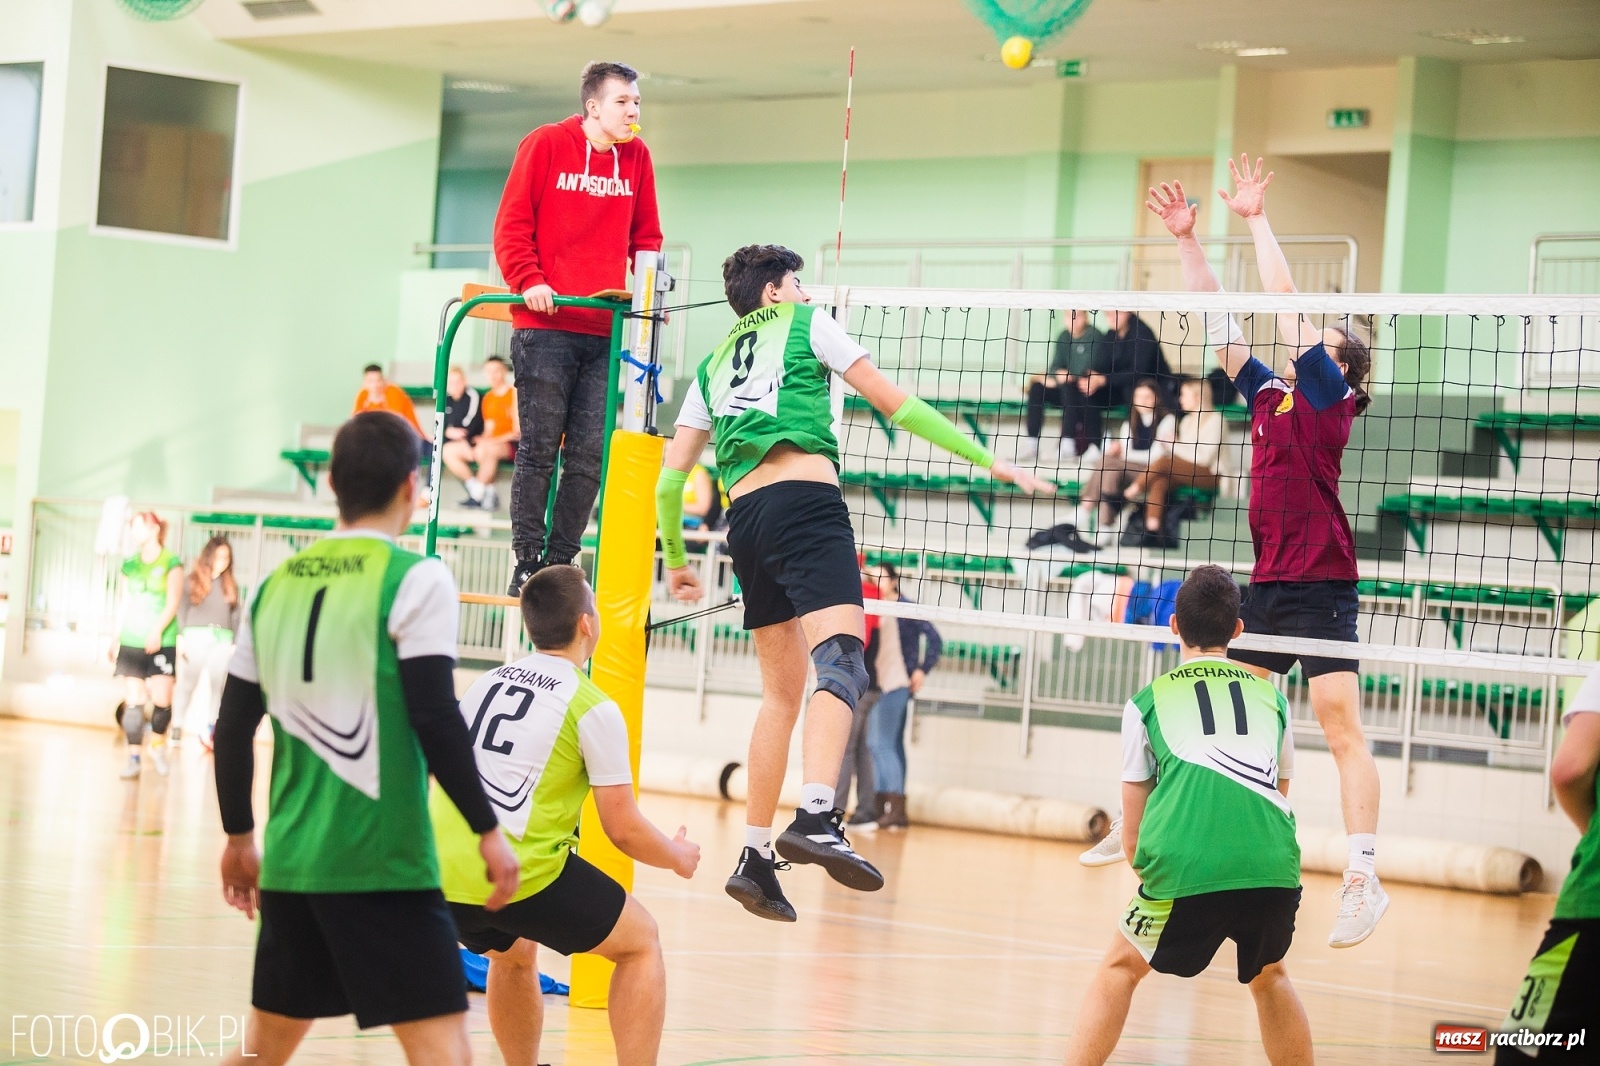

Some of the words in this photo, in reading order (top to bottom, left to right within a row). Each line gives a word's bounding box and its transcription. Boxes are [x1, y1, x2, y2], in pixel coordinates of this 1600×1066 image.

[730, 331, 757, 388] 9
[287, 555, 367, 578] MECHANIK
[303, 585, 328, 682] 1
[492, 666, 562, 691] MECHANIK
[468, 681, 535, 756] 12
[1194, 680, 1248, 735] 11
